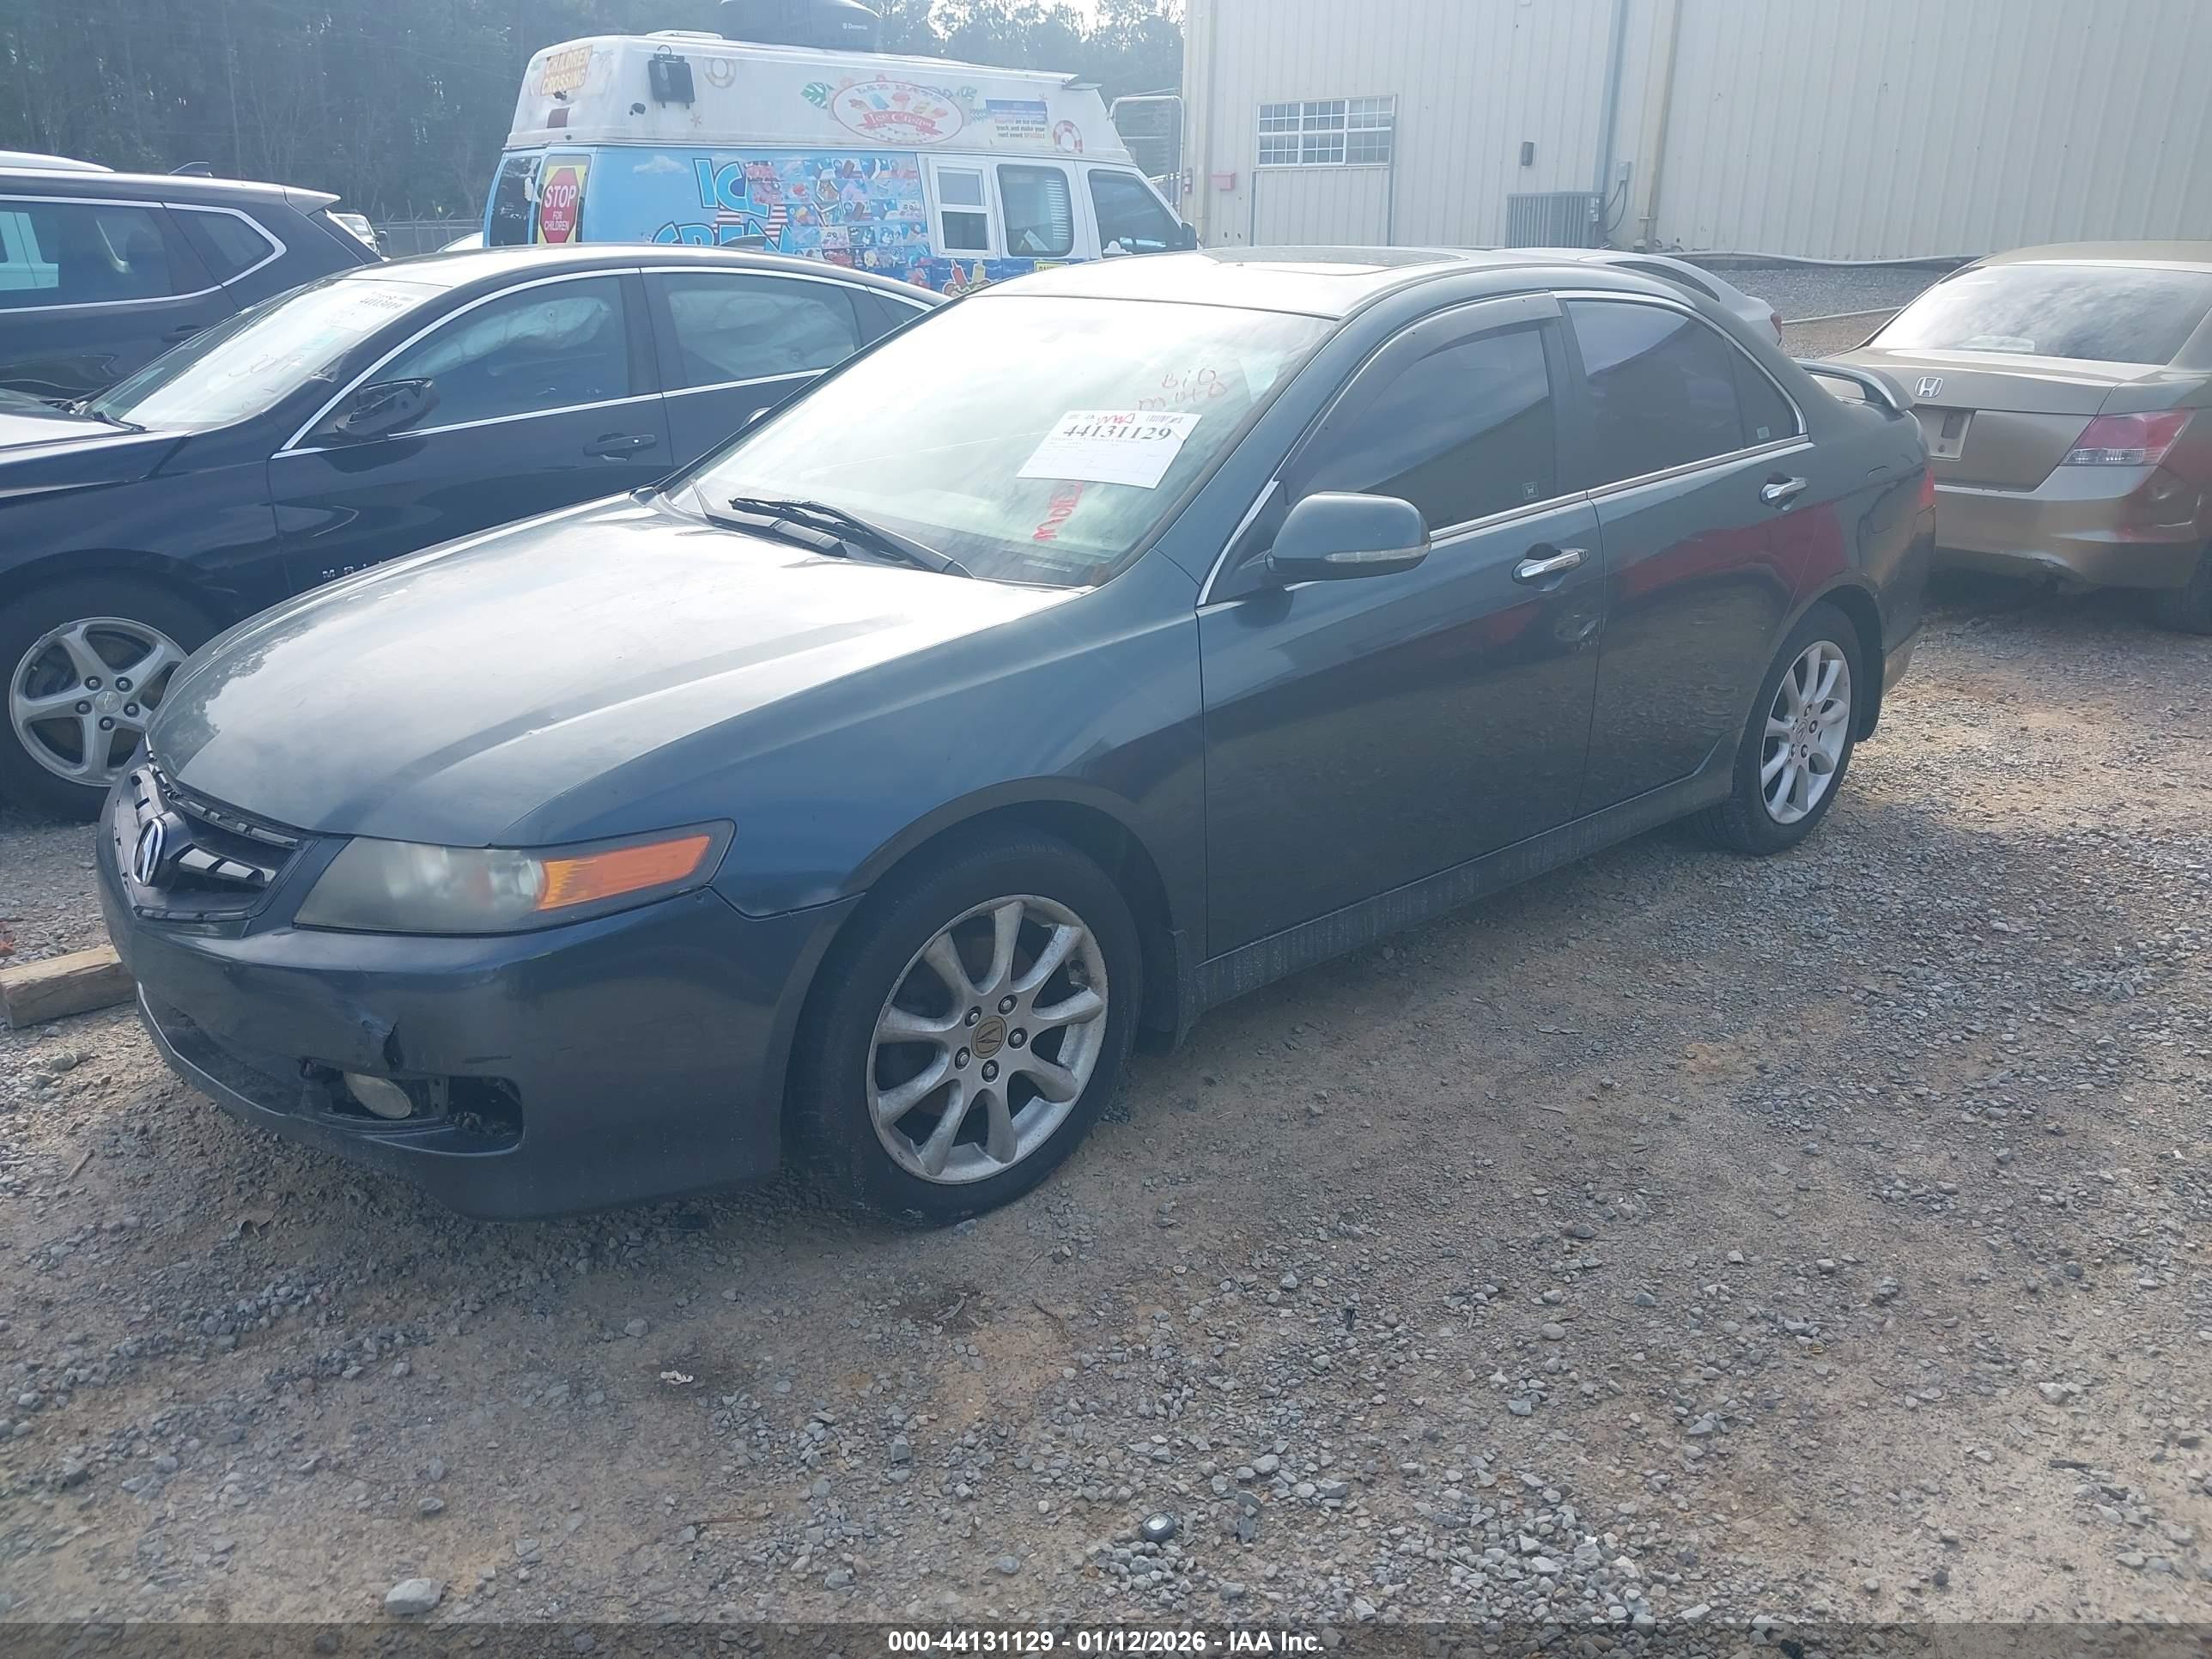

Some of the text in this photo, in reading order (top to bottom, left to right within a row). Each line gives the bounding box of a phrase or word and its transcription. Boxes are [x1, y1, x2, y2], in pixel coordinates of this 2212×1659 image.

[545, 46, 591, 75] CHILDREN
[541, 69, 586, 94] CROSSING
[544, 185, 577, 209] STOP
[552, 210, 563, 221] FOR
[544, 220, 570, 232] CHILDREN
[1062, 424, 1172, 441] 44131129
